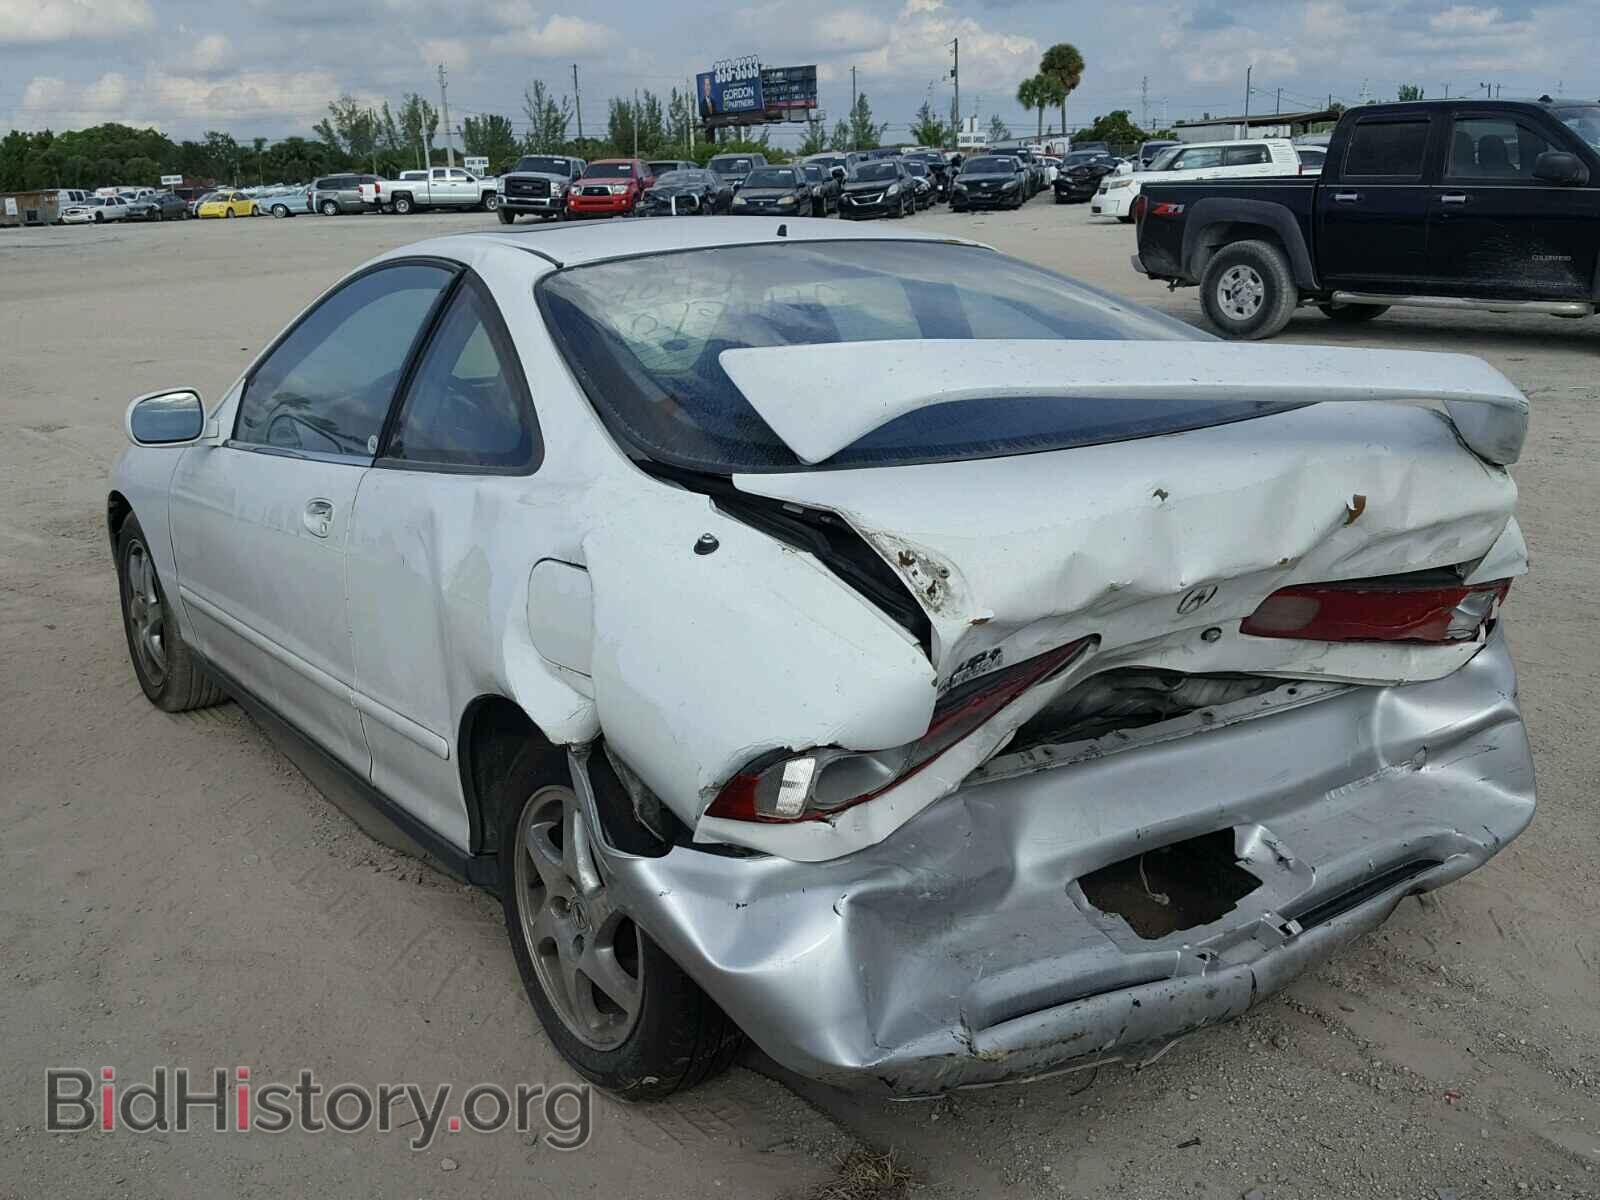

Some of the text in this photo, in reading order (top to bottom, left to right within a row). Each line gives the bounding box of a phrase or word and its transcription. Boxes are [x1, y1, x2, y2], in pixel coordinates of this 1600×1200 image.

[714, 55, 760, 83] 333-3333
[722, 86, 754, 99] GORDON
[728, 98, 755, 109] PARTNERS
